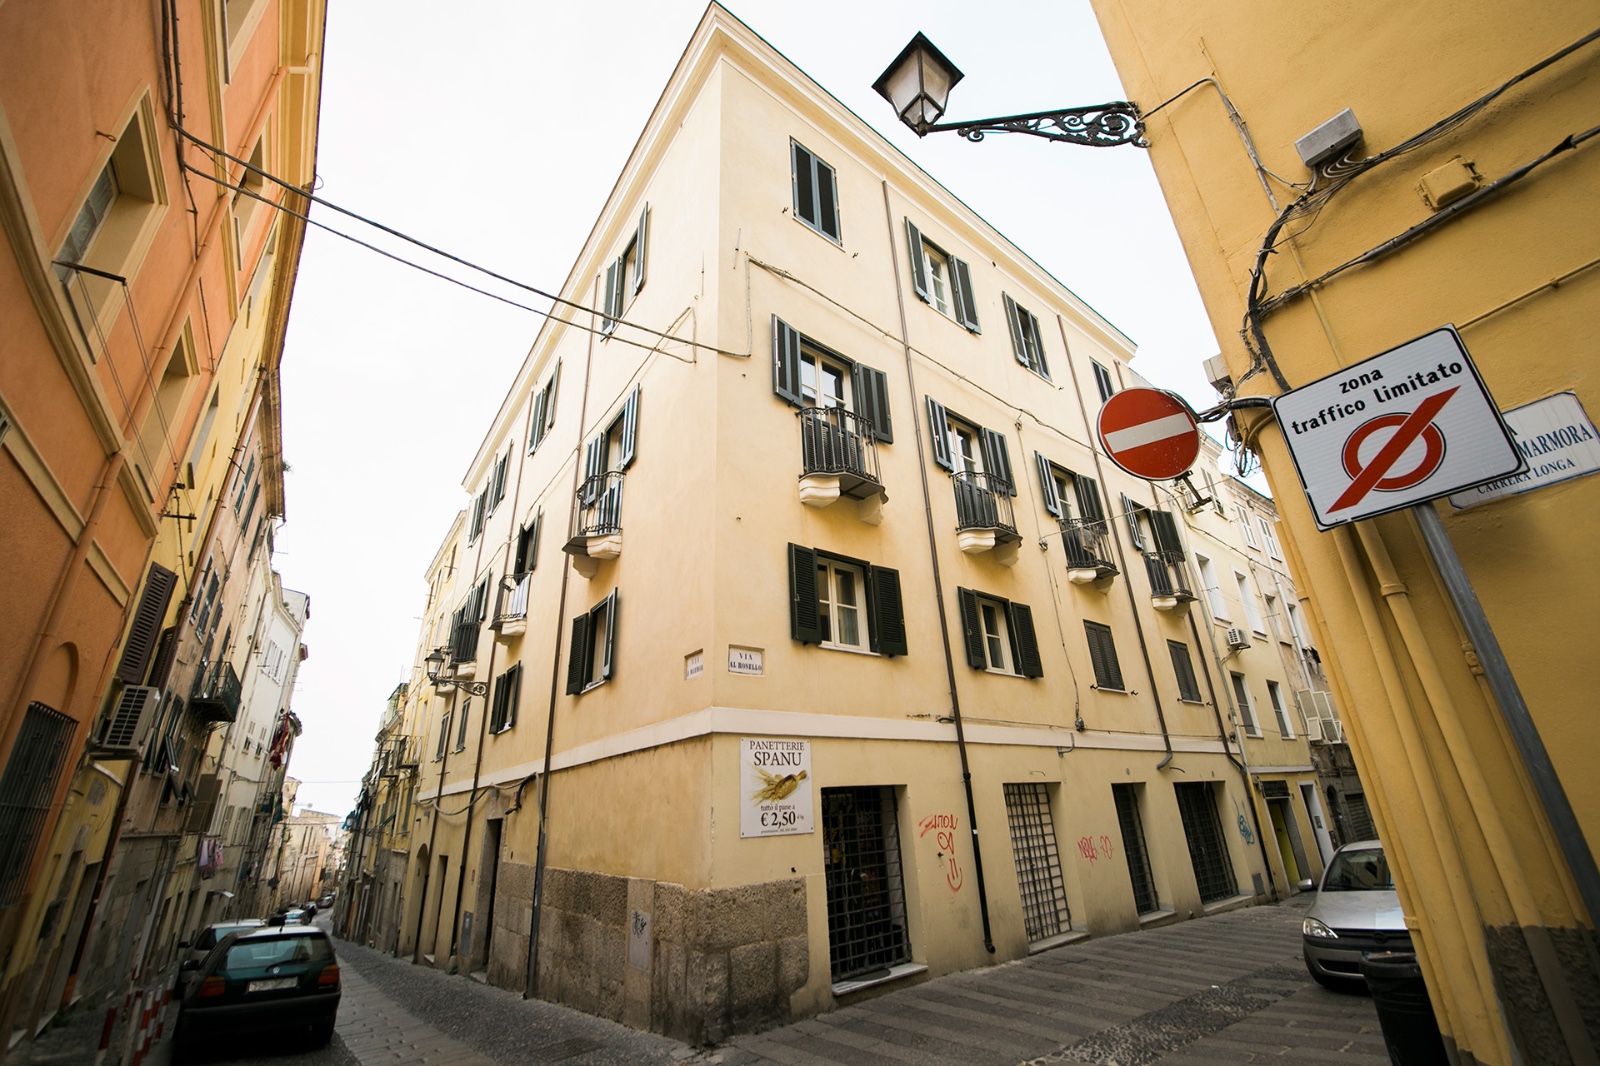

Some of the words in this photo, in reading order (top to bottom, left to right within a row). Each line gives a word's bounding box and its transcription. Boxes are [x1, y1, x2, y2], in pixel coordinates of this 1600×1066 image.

[1339, 369, 1384, 394] zona
[1292, 400, 1366, 435] traffico
[1373, 362, 1463, 403] limitato
[1517, 423, 1594, 459] MARMORA
[1477, 474, 1531, 494] CARRERA
[1533, 458, 1576, 477] LONGA
[749, 740, 805, 751] PANETTERIE
[753, 751, 802, 766] SPANU
[771, 811, 796, 828] 2,50
